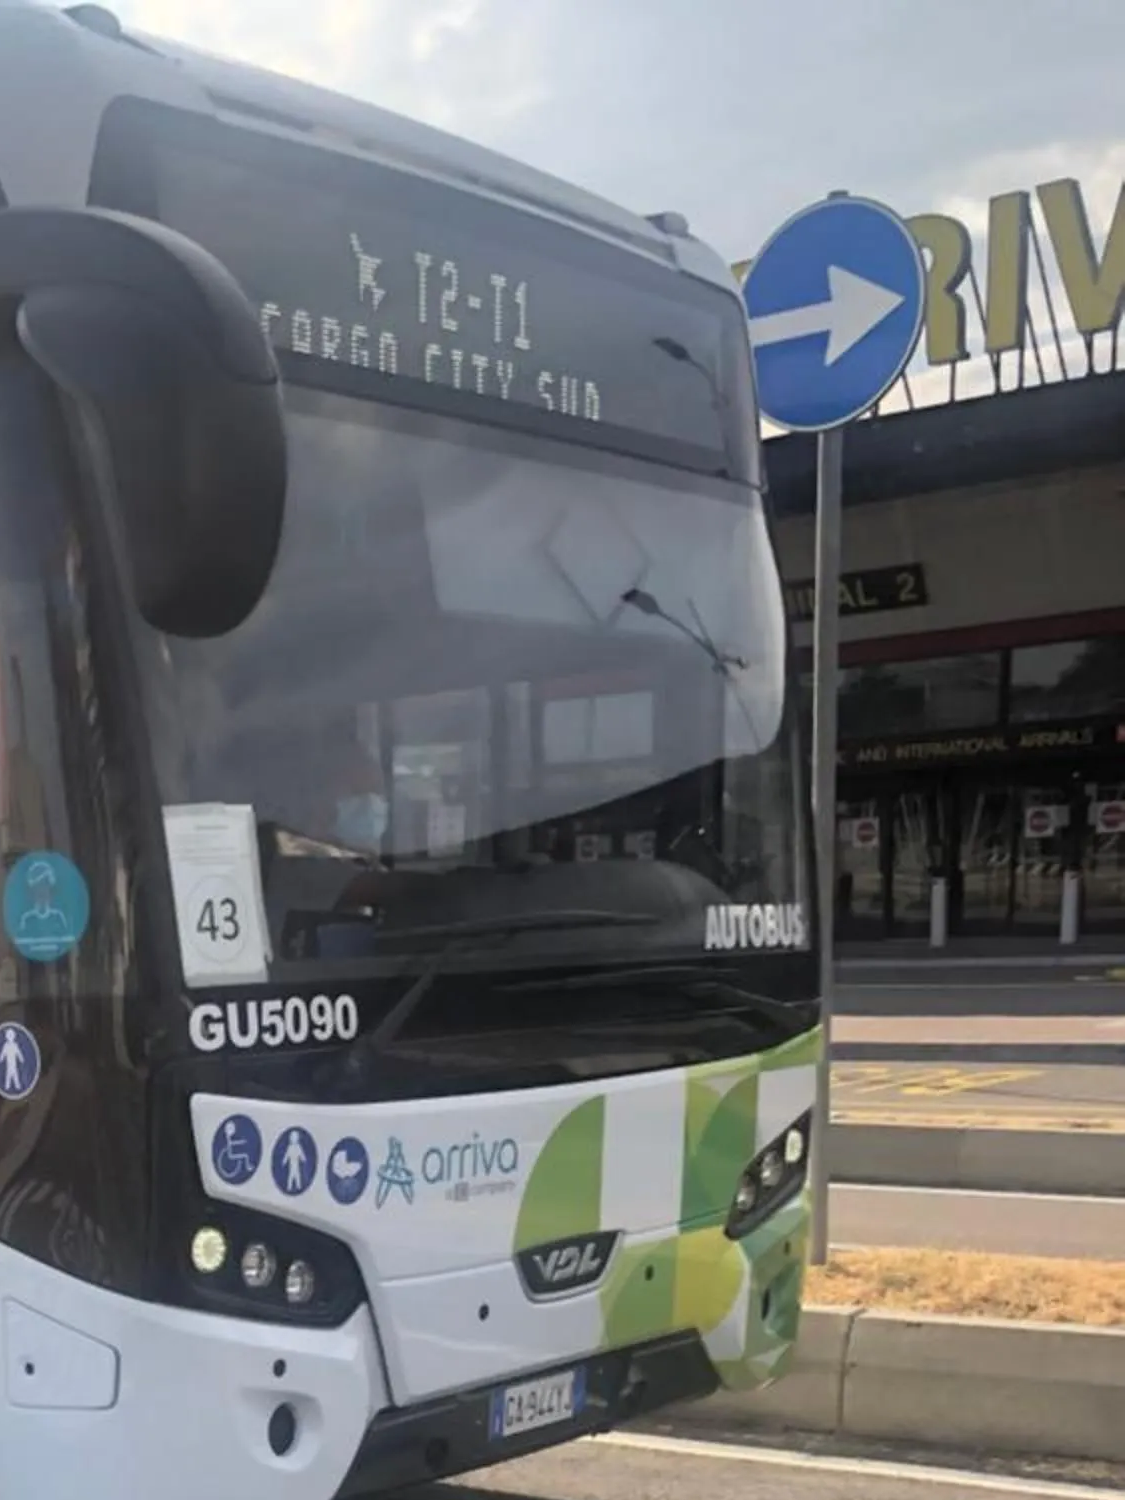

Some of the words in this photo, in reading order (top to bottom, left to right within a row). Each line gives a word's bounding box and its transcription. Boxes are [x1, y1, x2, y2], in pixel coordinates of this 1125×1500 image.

[903, 176, 1125, 367] RIV
[414, 250, 531, 351] T2-T1
[895, 570, 919, 602] 2
[195, 897, 242, 942] 43
[704, 902, 810, 951] AUTOBUS
[187, 993, 359, 1052] GU5090
[421, 1130, 520, 1185] arriva
[531, 1242, 603, 1283] VDL
